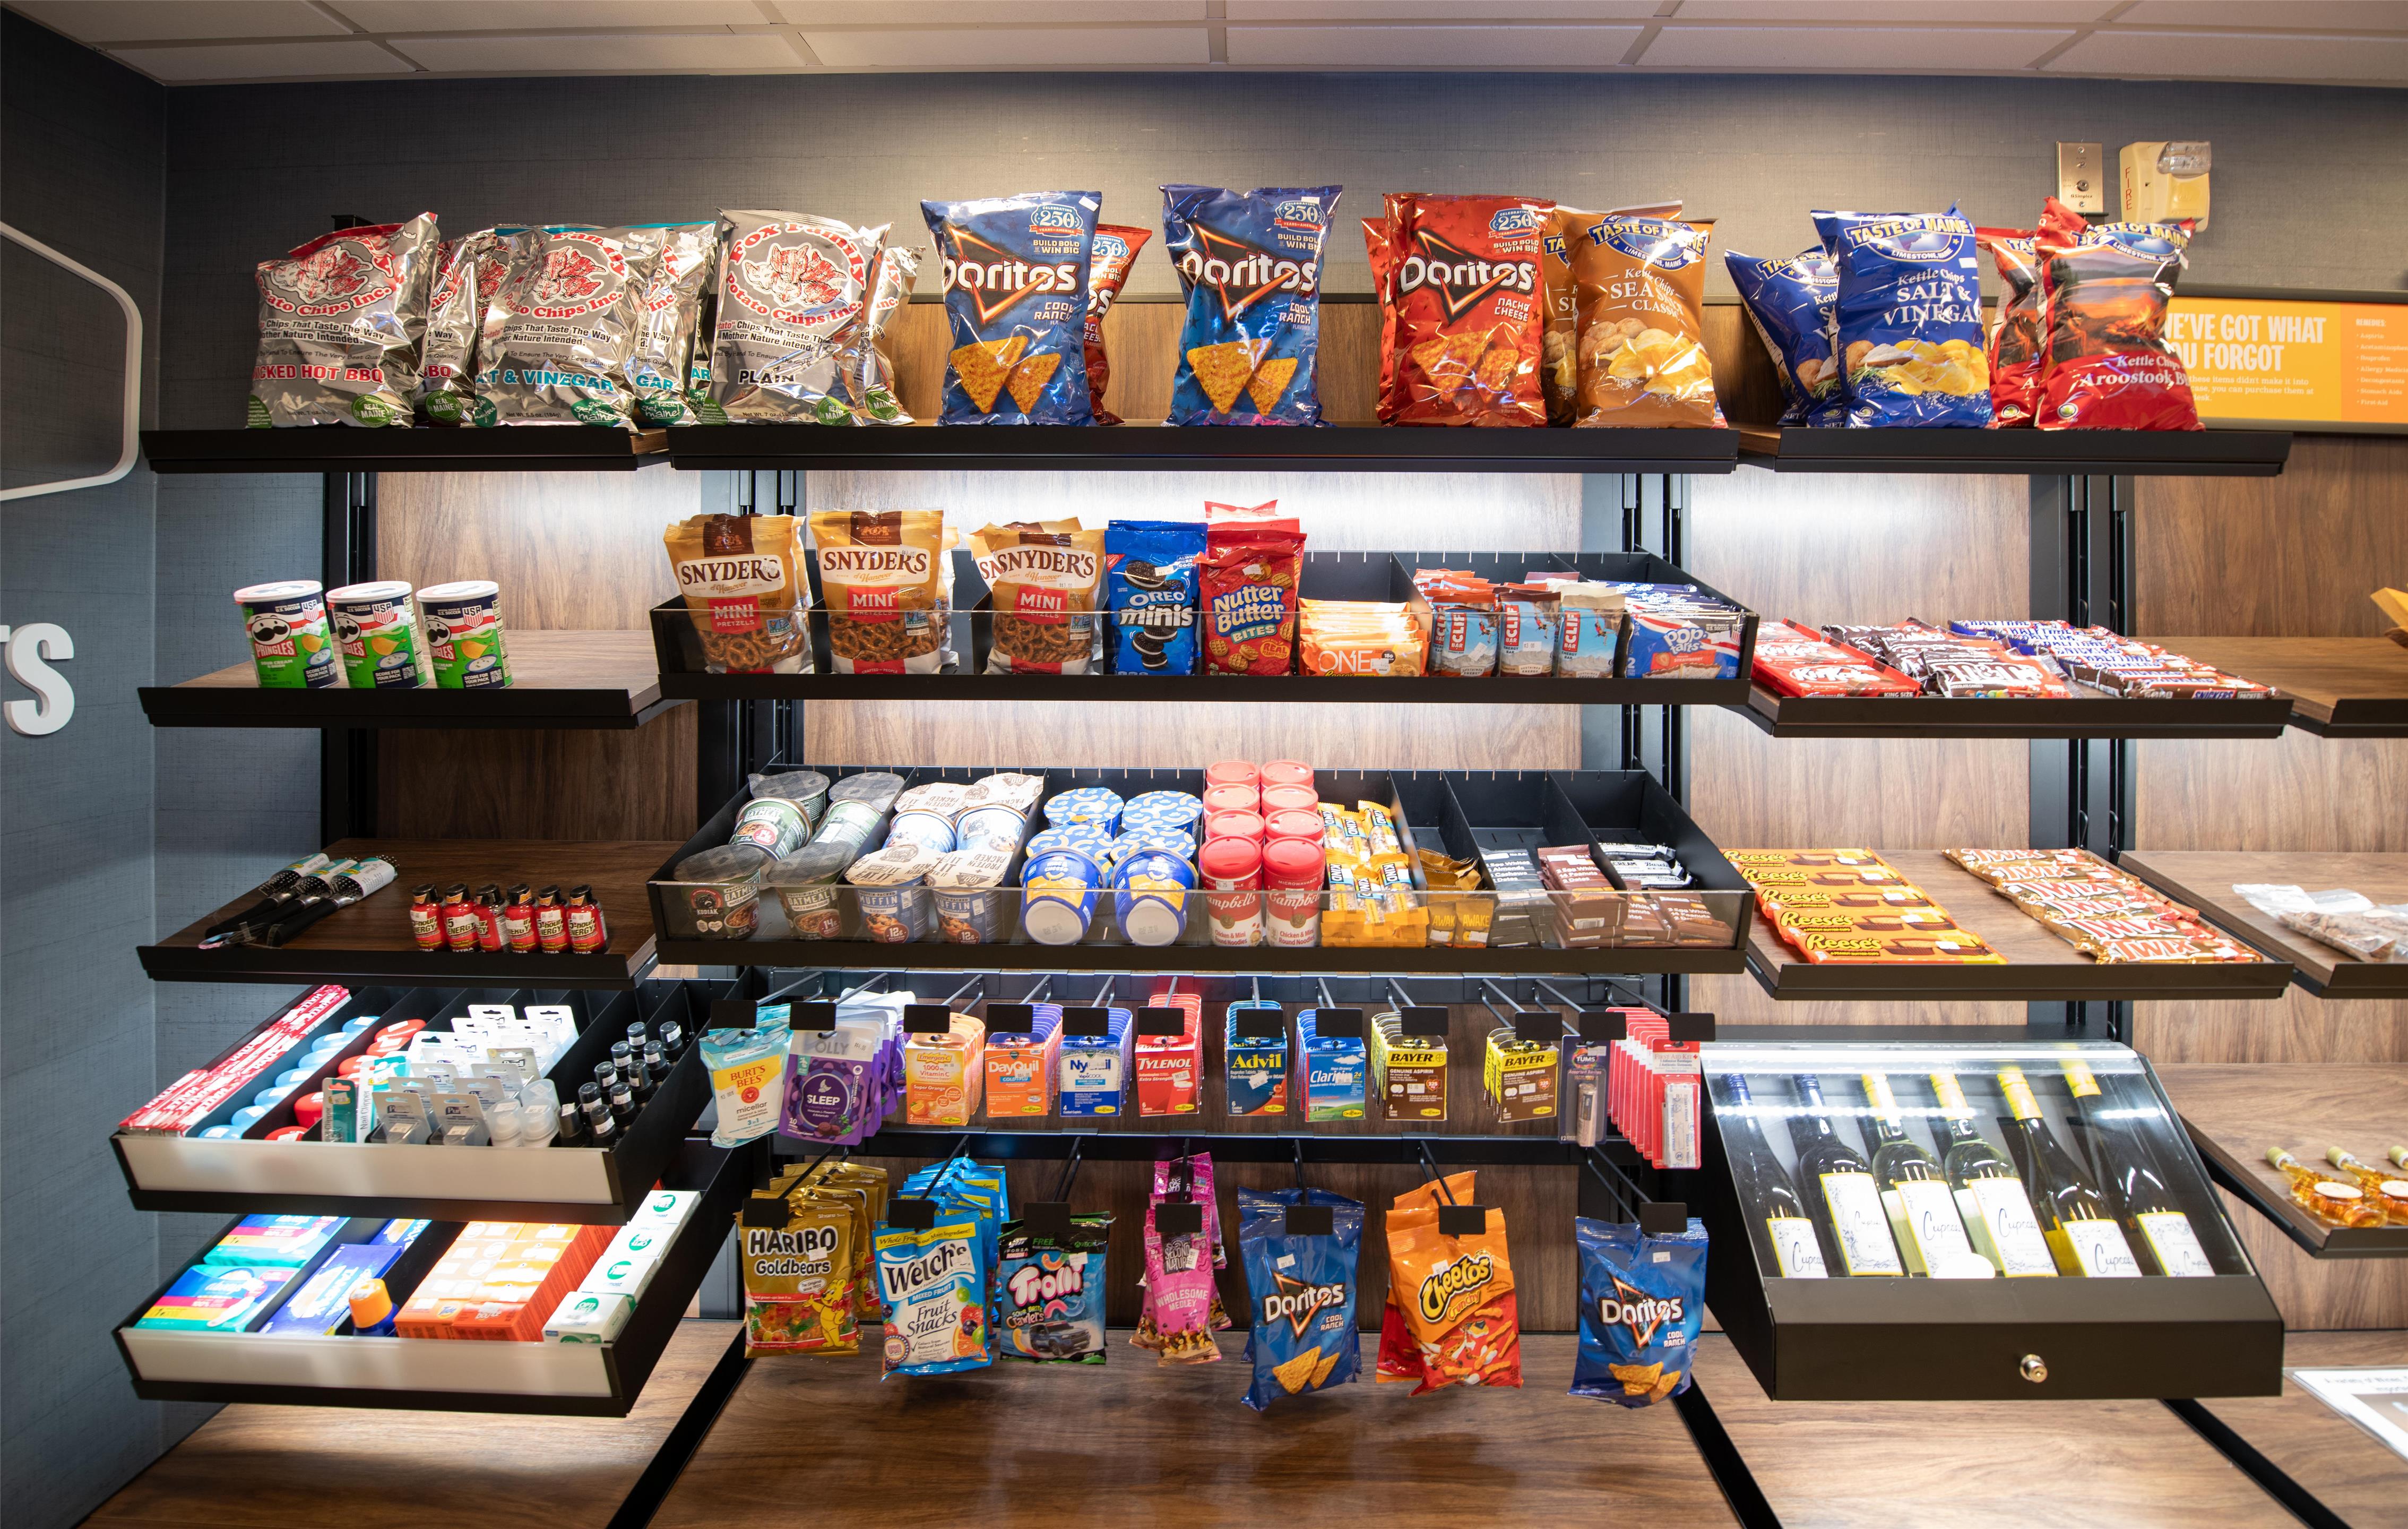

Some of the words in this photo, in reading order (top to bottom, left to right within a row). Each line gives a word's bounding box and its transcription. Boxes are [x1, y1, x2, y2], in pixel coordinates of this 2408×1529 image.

[1039, 210, 1075, 228] 250
[1284, 205, 1318, 223] 250
[1592, 223, 1642, 243] TASTE
[1642, 225, 1660, 235] OF
[1850, 220, 1905, 244] TASTE
[1906, 218, 1922, 231] OF
[1926, 217, 1971, 234] MAINE
[1286, 240, 1306, 249] WIN
[1180, 251, 1317, 292] Doritos
[1400, 255, 1535, 292] Doritos
[1896, 268, 1939, 287] Kettle
[1610, 281, 1654, 299] SEA
[1897, 281, 1955, 302] SALT
[1957, 285, 1973, 302] &
[725, 271, 769, 316] Potato
[772, 308, 826, 327] Chips
[1497, 297, 1531, 312] NACHO
[298, 303, 350, 317] Chips
[534, 305, 585, 319] Chips
[1290, 302, 1310, 314] COOL
[1494, 307, 1529, 322] CHEESE
[1279, 312, 1311, 324] RANCH
[283, 330, 314, 340] Nature
[314, 322, 339, 331] Taste
[342, 323, 360, 334] The
[363, 328, 384, 340] Way
[524, 324, 545, 333] That
[546, 325, 569, 334] Taste
[572, 327, 589, 336] The
[591, 330, 611, 342] Way
[763, 325, 783, 337] That
[786, 330, 810, 341] Taste
[2220, 314, 2262, 341] GOT
[2267, 315, 2327, 344] WHAT
[512, 334, 542, 343] Nature
[722, 332, 748, 342] Mother
[750, 333, 781, 346] Nature
[327, 352, 345, 360] Very
[2203, 342, 2285, 372] FORGOT
[300, 365, 341, 381] HOT
[344, 367, 385, 384] BBQ
[503, 370, 518, 384] &
[524, 370, 615, 392] VINEGAR
[2078, 371, 2173, 389] Aroostook
[2236, 376, 2259, 385] didn't
[2245, 386, 2282, 397] purchase
[823, 551, 928, 575] SNYDER'S
[999, 549, 1095, 578] SNYDER'S
[852, 593, 893, 607] MINI
[1020, 592, 1062, 610] MINI
[1129, 591, 1186, 608] OREO
[1213, 585, 1283, 616] Nutter
[373, 604, 392, 613] USA
[714, 603, 755, 620] MINI
[1119, 604, 1194, 628] minis
[1217, 603, 1284, 633] Butter
[1232, 624, 1275, 642] BITES
[255, 641, 295, 659] PRINGLES
[1318, 649, 1374, 673] ONE
[2193, 690, 2234, 699] SNICKERS
[1322, 810, 1335, 826] KIND
[1345, 819, 1359, 836] KIND
[1723, 849, 1788, 863] Reese's
[1741, 867, 1808, 882] Reese's
[788, 891, 831, 906] OATMEAL
[1462, 914, 1490, 927] AWAKE
[815, 1041, 849, 1055] OLLY
[1137, 1058, 1193, 1071] TYLENOL
[1230, 1053, 1283, 1069] Advil
[1390, 1053, 1434, 1062] BAYER
[1504, 1054, 1546, 1068] BAYER
[730, 1064, 766, 1081] BURT'S
[736, 1076, 762, 1088] BEES
[736, 1100, 767, 1115] micellar
[806, 1094, 841, 1106] SLEEP
[748, 1225, 839, 1257] HARIBO
[879, 1235, 902, 1245] Whole
[1032, 1238, 1054, 1246] FREE
[754, 1259, 832, 1276] Goldbears
[911, 1291, 933, 1302] MIXED
[933, 1282, 953, 1296] FRUIT
[1008, 1264, 1084, 1308] Trolli
[1420, 1255, 1493, 1321] Cheetos
[1155, 1288, 1209, 1308] WHOLESOME
[1169, 1299, 1197, 1312] MEDLEY
[1264, 1283, 1345, 1324] Doritos
[916, 1299, 951, 1323] Fruit
[1602, 1298, 1684, 1325] Doritos
[905, 1310, 957, 1338] Snacks
[1006, 1311, 1046, 1329] Crawlers
